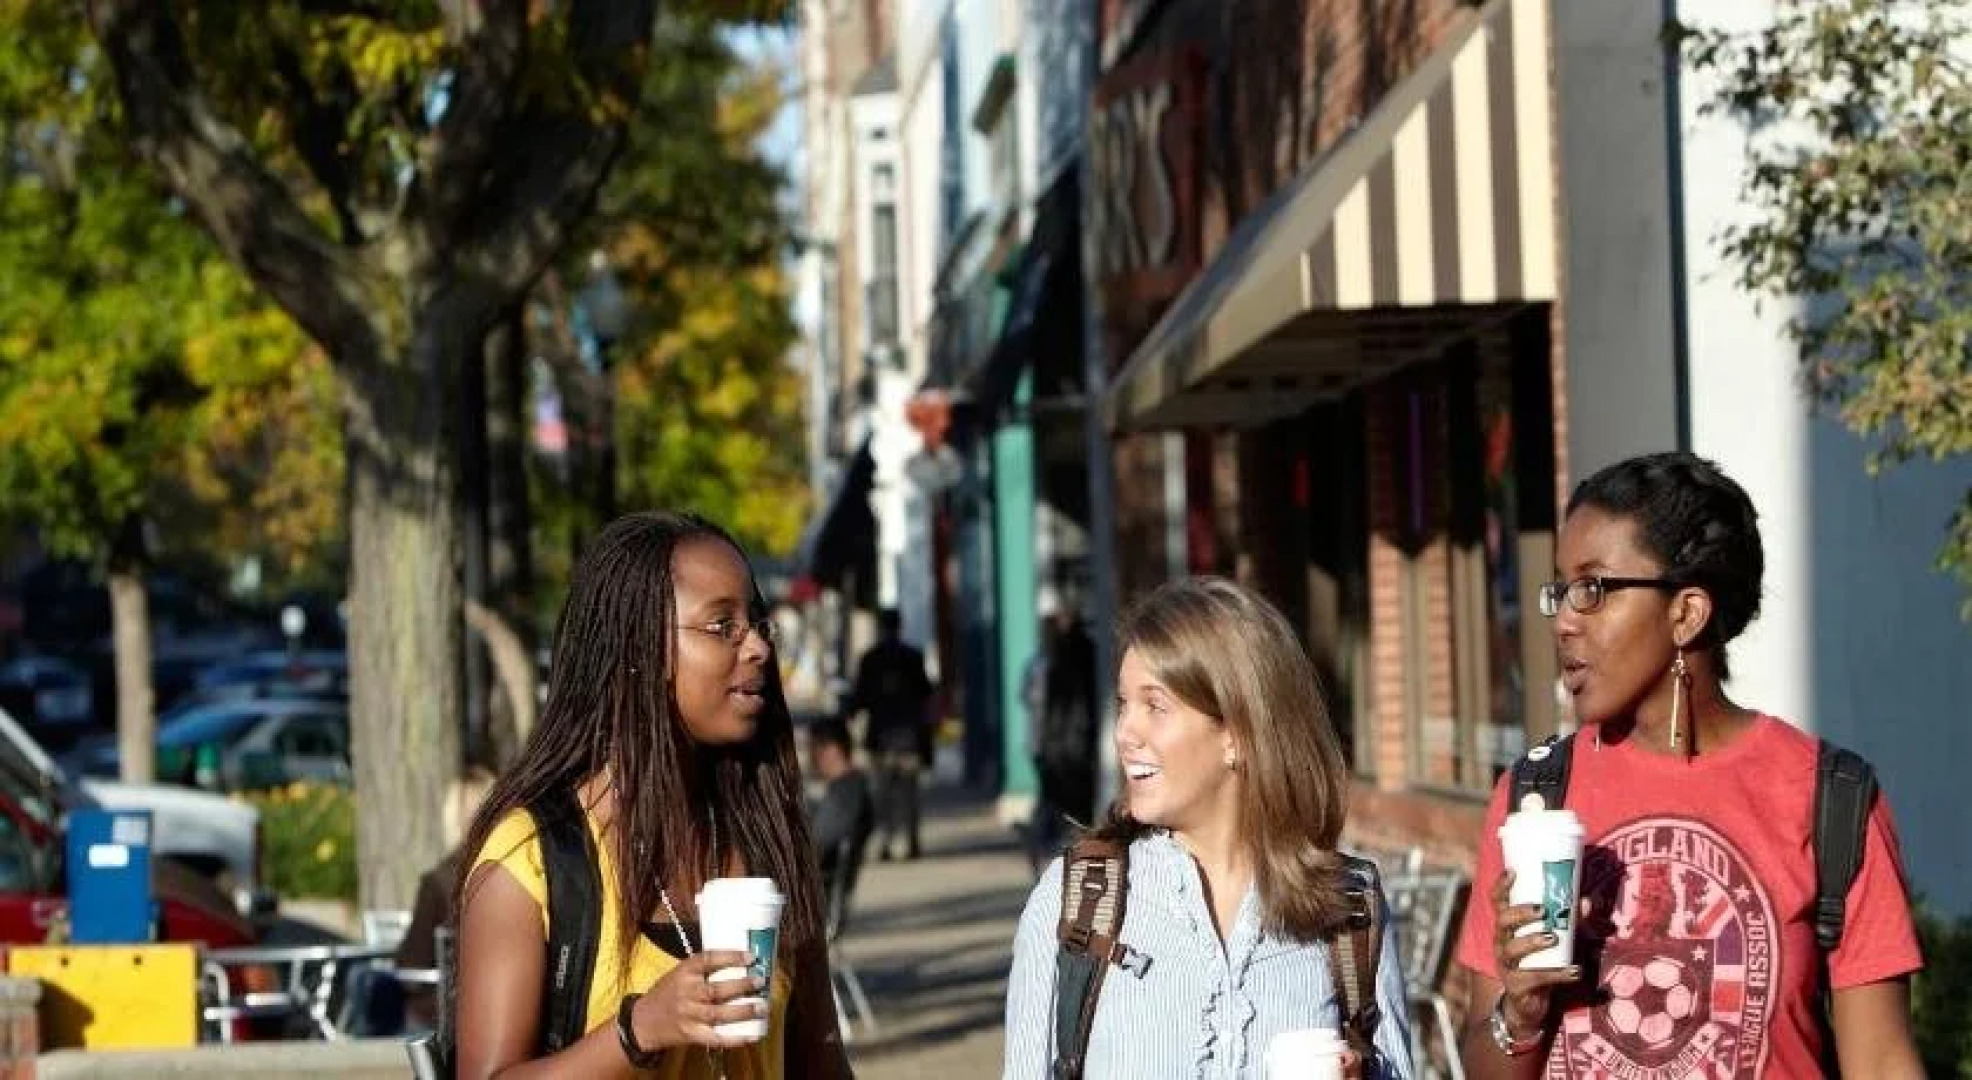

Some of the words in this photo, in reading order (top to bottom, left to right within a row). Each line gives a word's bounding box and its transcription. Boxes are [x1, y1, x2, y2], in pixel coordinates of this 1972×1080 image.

[1609, 828, 1730, 886] NGLAND
[1746, 911, 1769, 987] ASSOC
[1740, 995, 1764, 1069] LEAGUE
